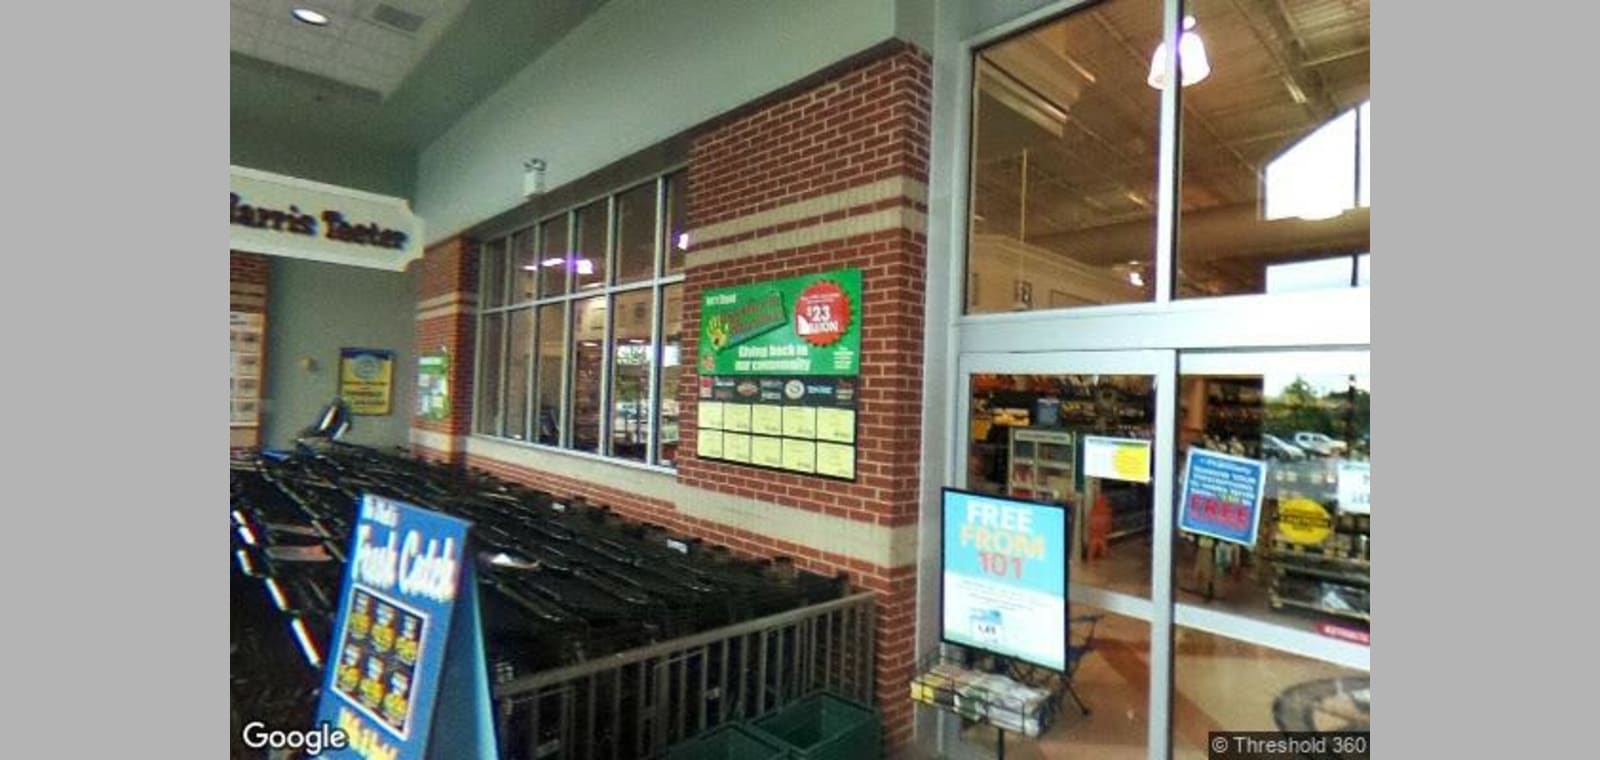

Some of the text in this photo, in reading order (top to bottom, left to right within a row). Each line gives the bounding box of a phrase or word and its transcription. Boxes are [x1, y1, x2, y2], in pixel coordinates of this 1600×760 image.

[769, 344, 795, 356] back
[966, 501, 1033, 533] FREE
[1190, 492, 1250, 530] FREE
[960, 522, 1046, 560] FROM
[978, 551, 1022, 579] 101
